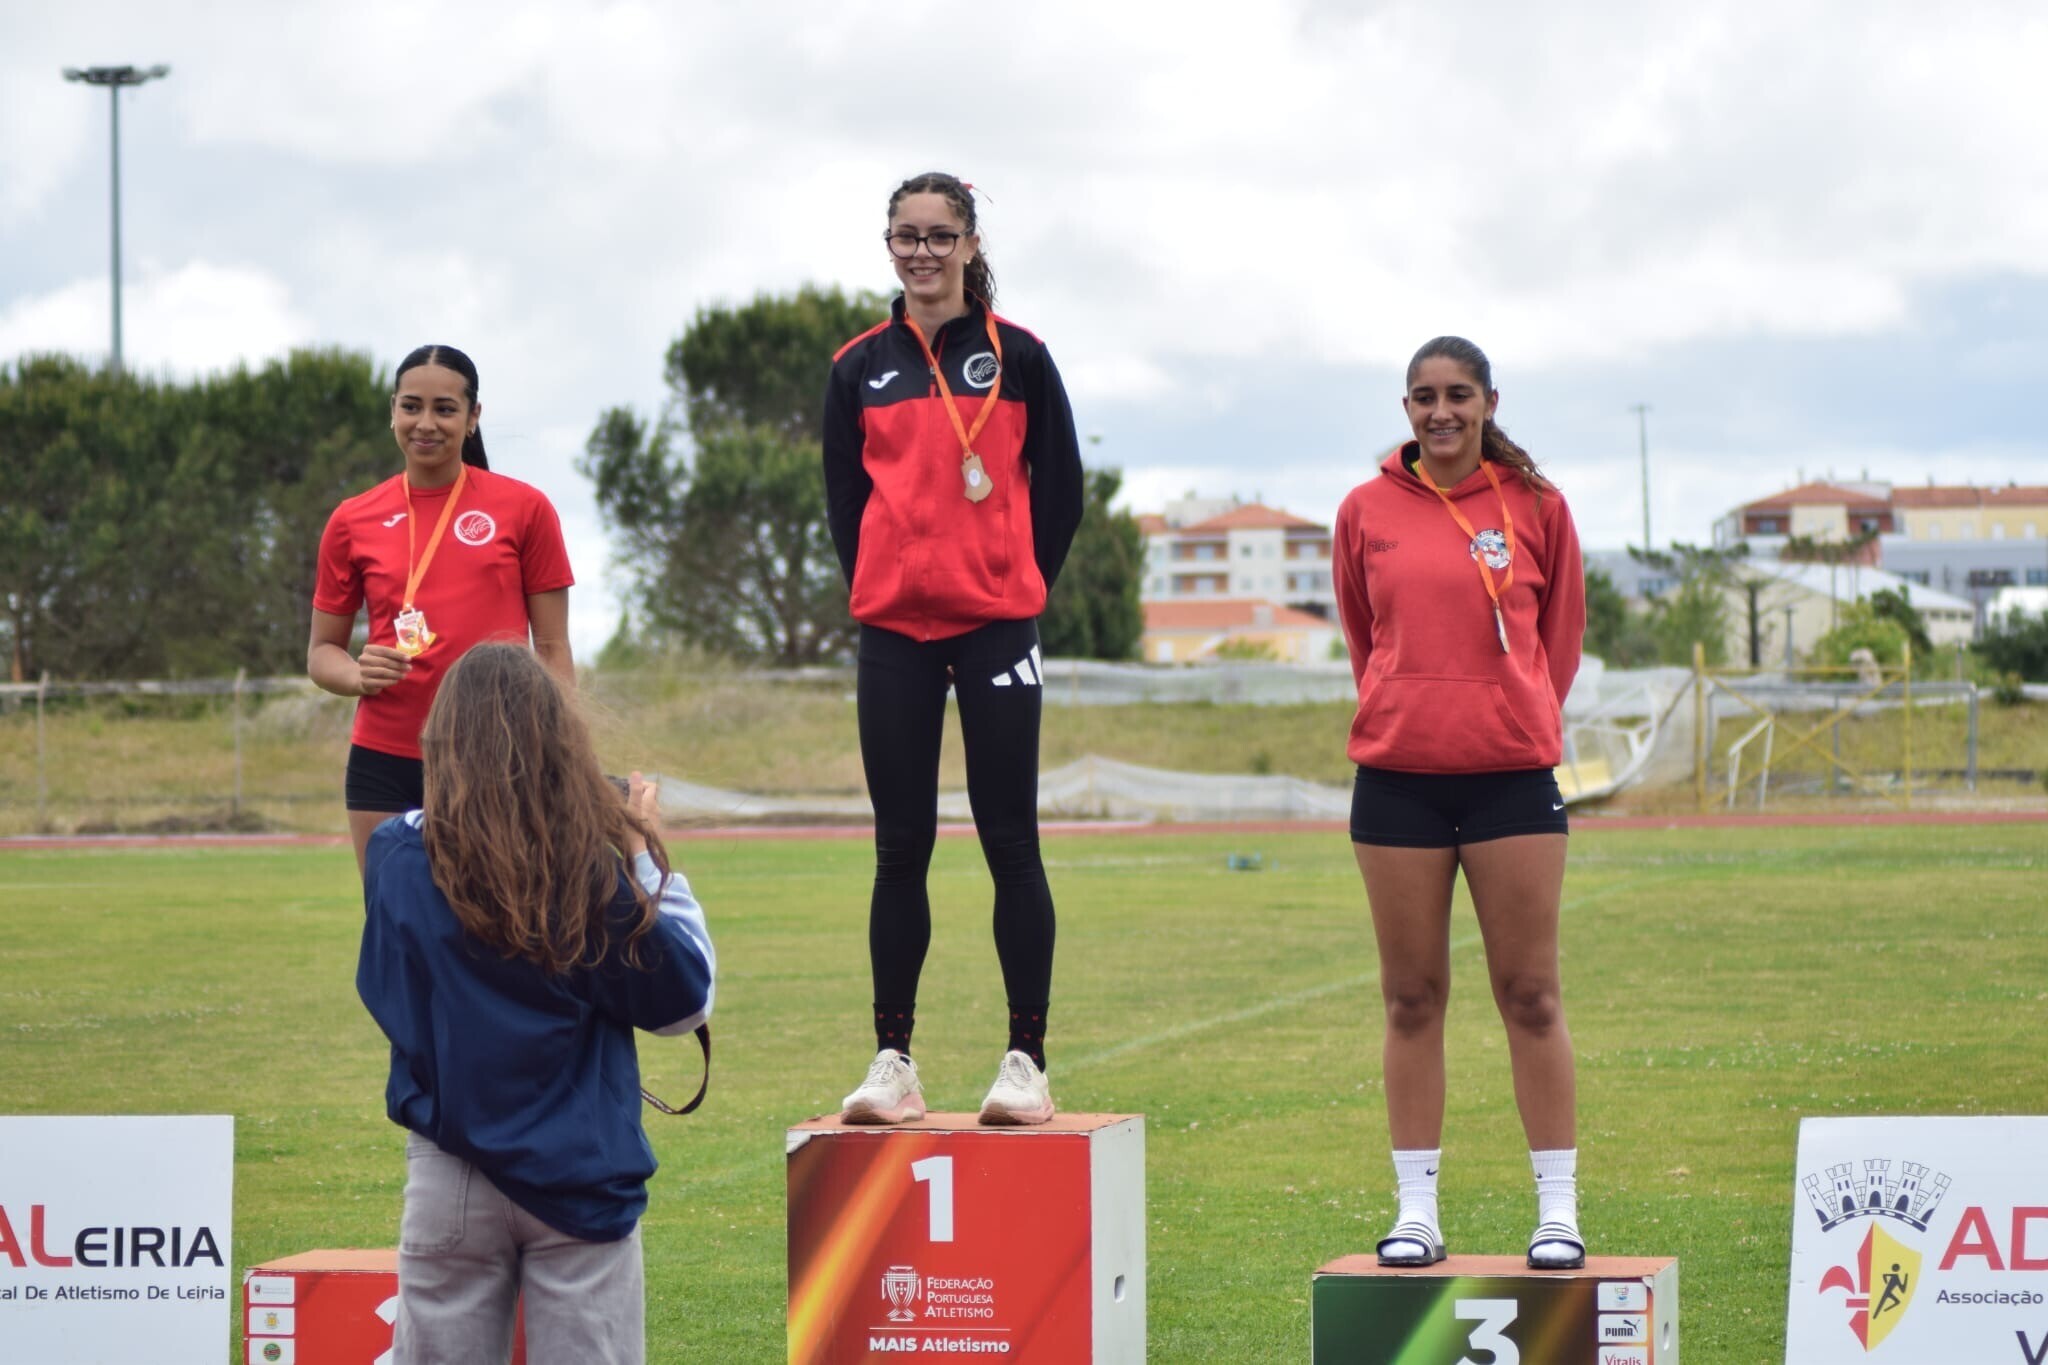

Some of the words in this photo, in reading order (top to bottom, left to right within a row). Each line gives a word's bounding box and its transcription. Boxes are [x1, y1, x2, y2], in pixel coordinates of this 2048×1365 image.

[911, 1156, 954, 1242] 1
[927, 1277, 994, 1291] FEDERAÇÃO
[25, 1286, 48, 1300] De
[55, 1286, 140, 1300] Atletismo
[147, 1286, 170, 1300] De
[177, 1286, 225, 1300] Leiria
[927, 1291, 993, 1304] PORTUGUESA
[1936, 1289, 2044, 1306] Associação
[925, 1305, 994, 1318] ATLETISMO
[1454, 1299, 1520, 1365] 3
[1605, 1327, 1633, 1336] PUMA
[869, 1337, 918, 1352] MAIS
[922, 1337, 1011, 1353] Atletismo
[1605, 1354, 1641, 1365] Vitalis
